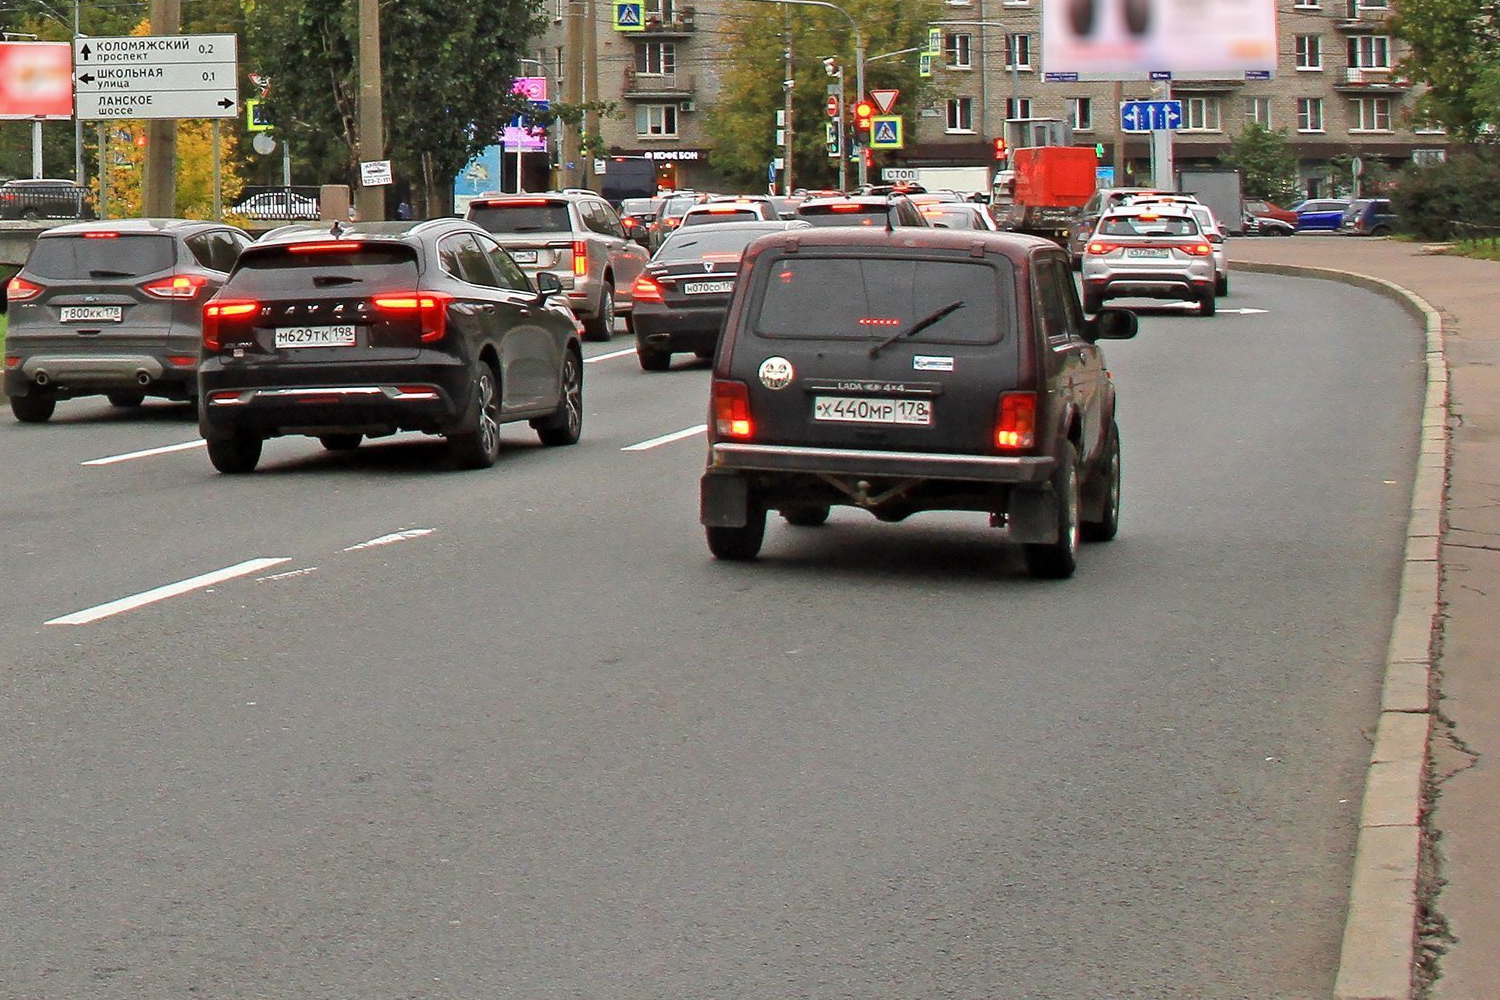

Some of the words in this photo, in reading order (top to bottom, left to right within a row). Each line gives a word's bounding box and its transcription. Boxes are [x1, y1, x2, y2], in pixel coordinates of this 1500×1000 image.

[96, 39, 190, 52] КОЛОМЯЖСКИЙ
[198, 44, 214, 55] 0,2
[97, 53, 148, 62] проспект
[97, 68, 163, 79] ШКОЛЬНАЯ
[202, 72, 215, 82] 0,1
[97, 79, 130, 90] улица
[98, 95, 153, 106] ЛАНСКОЕ
[98, 106, 133, 115] шоссе
[653, 151, 678, 160] КОФЕ
[678, 151, 698, 160] БОН
[887, 169, 914, 179] СТОП
[64, 308, 101, 319] Т800КК
[105, 307, 120, 316] 178
[278, 329, 329, 343] М629ТК
[333, 326, 351, 339] 198
[837, 382, 862, 391] LADA
[823, 402, 893, 419] Х440МР
[898, 402, 925, 416] 178
